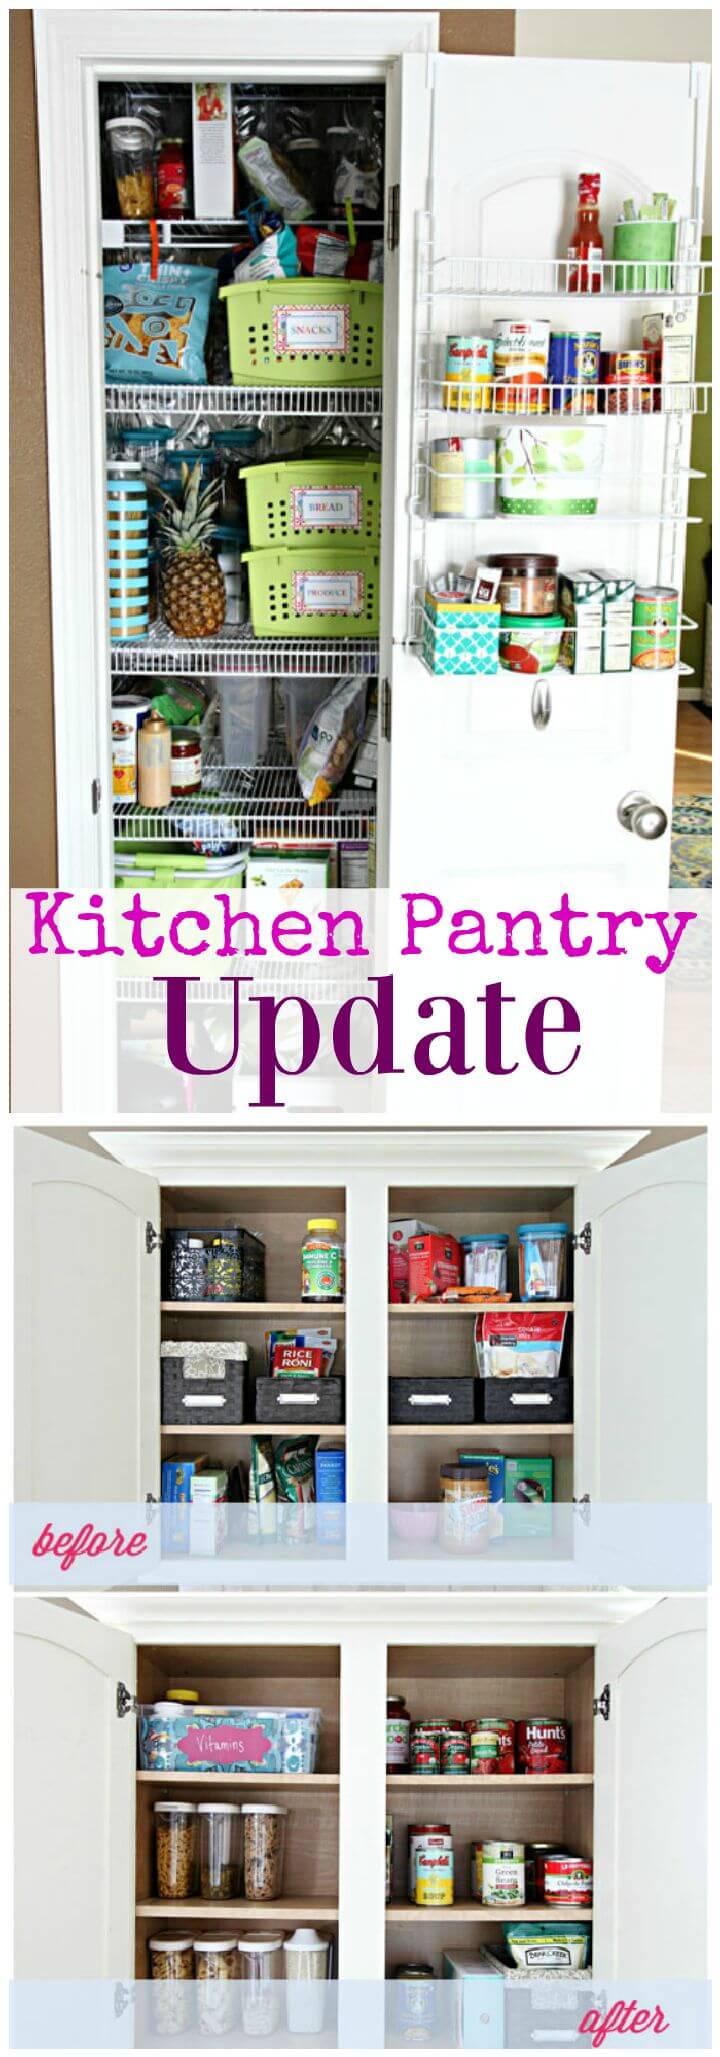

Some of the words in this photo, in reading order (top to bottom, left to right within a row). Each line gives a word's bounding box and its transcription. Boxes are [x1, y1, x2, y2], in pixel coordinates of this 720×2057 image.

[290, 325, 333, 335] SNACKS
[308, 501, 343, 512] BREAD
[306, 588, 347, 597] PRODUCE
[282, 1350, 313, 1359] RICE
[281, 1358, 313, 1367] RONI
[526, 1725, 566, 1740] Hunt's
[196, 1734, 245, 1753] Vitamins
